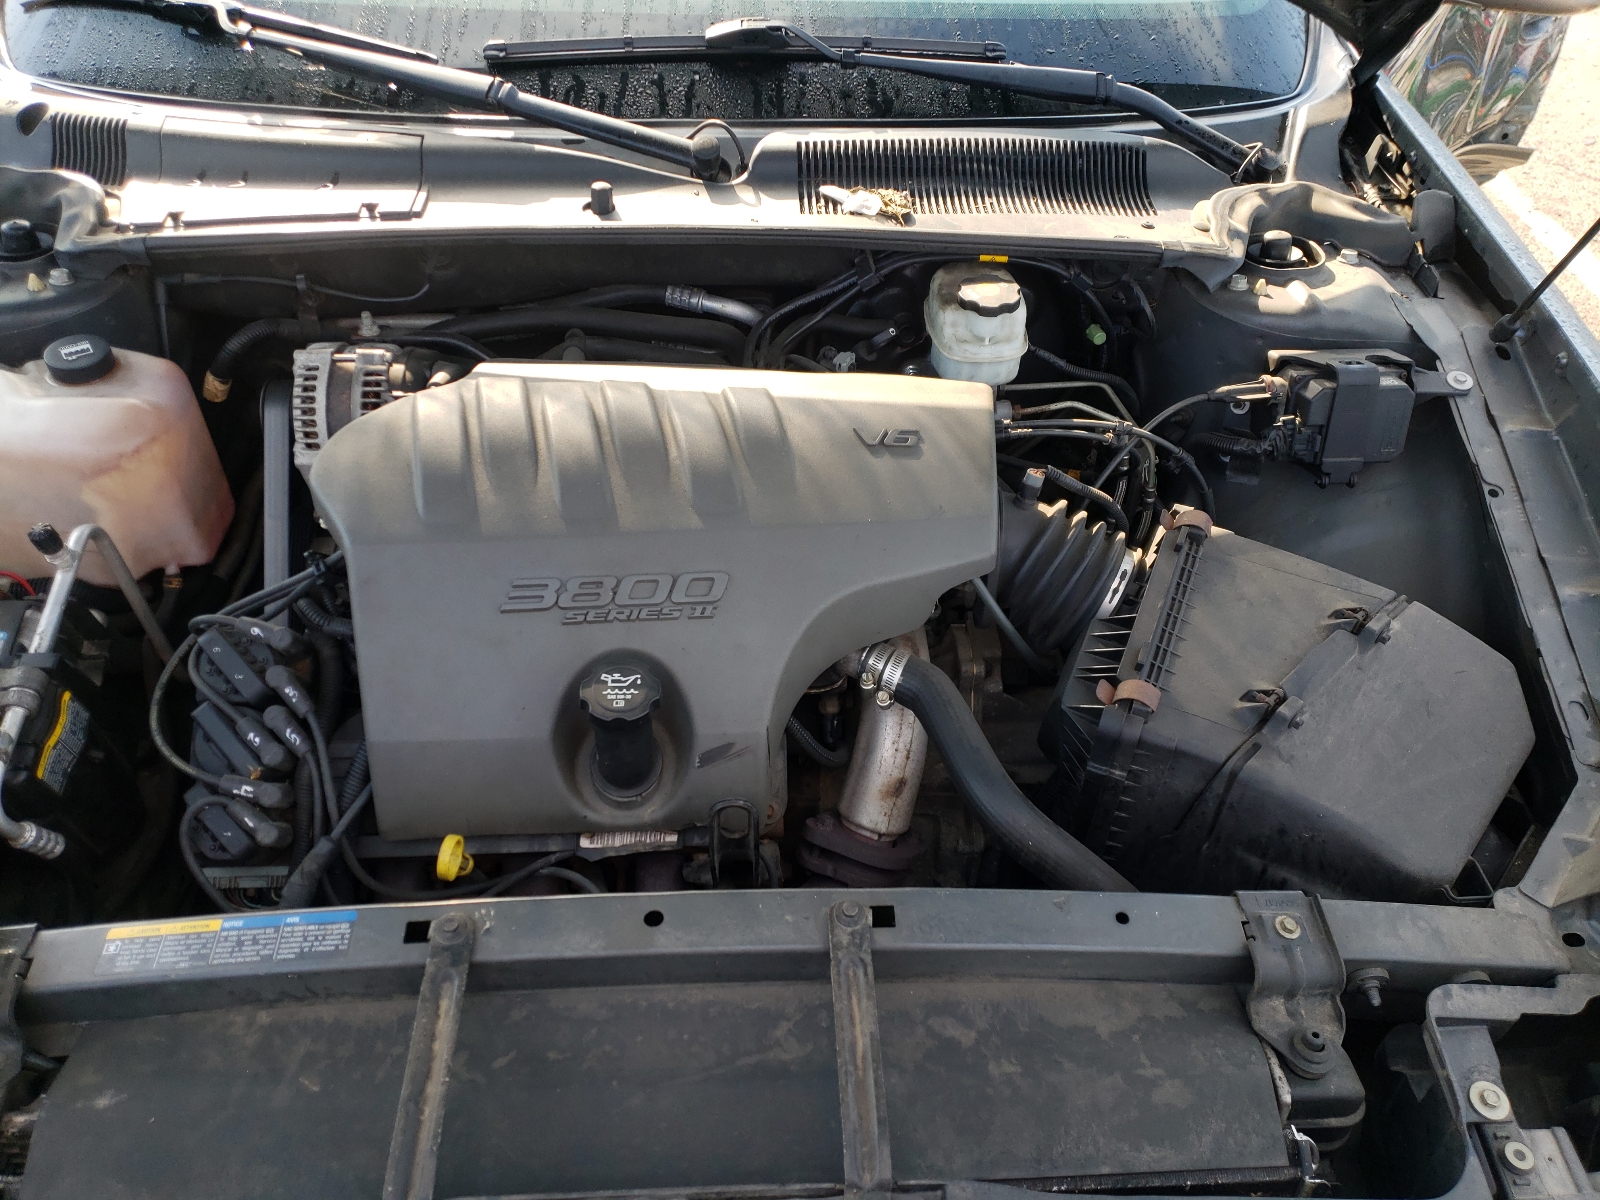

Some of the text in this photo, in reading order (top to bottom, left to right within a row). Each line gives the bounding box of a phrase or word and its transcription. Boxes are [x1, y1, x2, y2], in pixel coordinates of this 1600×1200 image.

[852, 427, 919, 447] V6
[500, 571, 729, 614] 3800
[562, 605, 717, 626] SERIES II
[247, 732, 261, 747] 2
[285, 727, 300, 746] 5
[180, 923, 211, 931] ATTENTION
